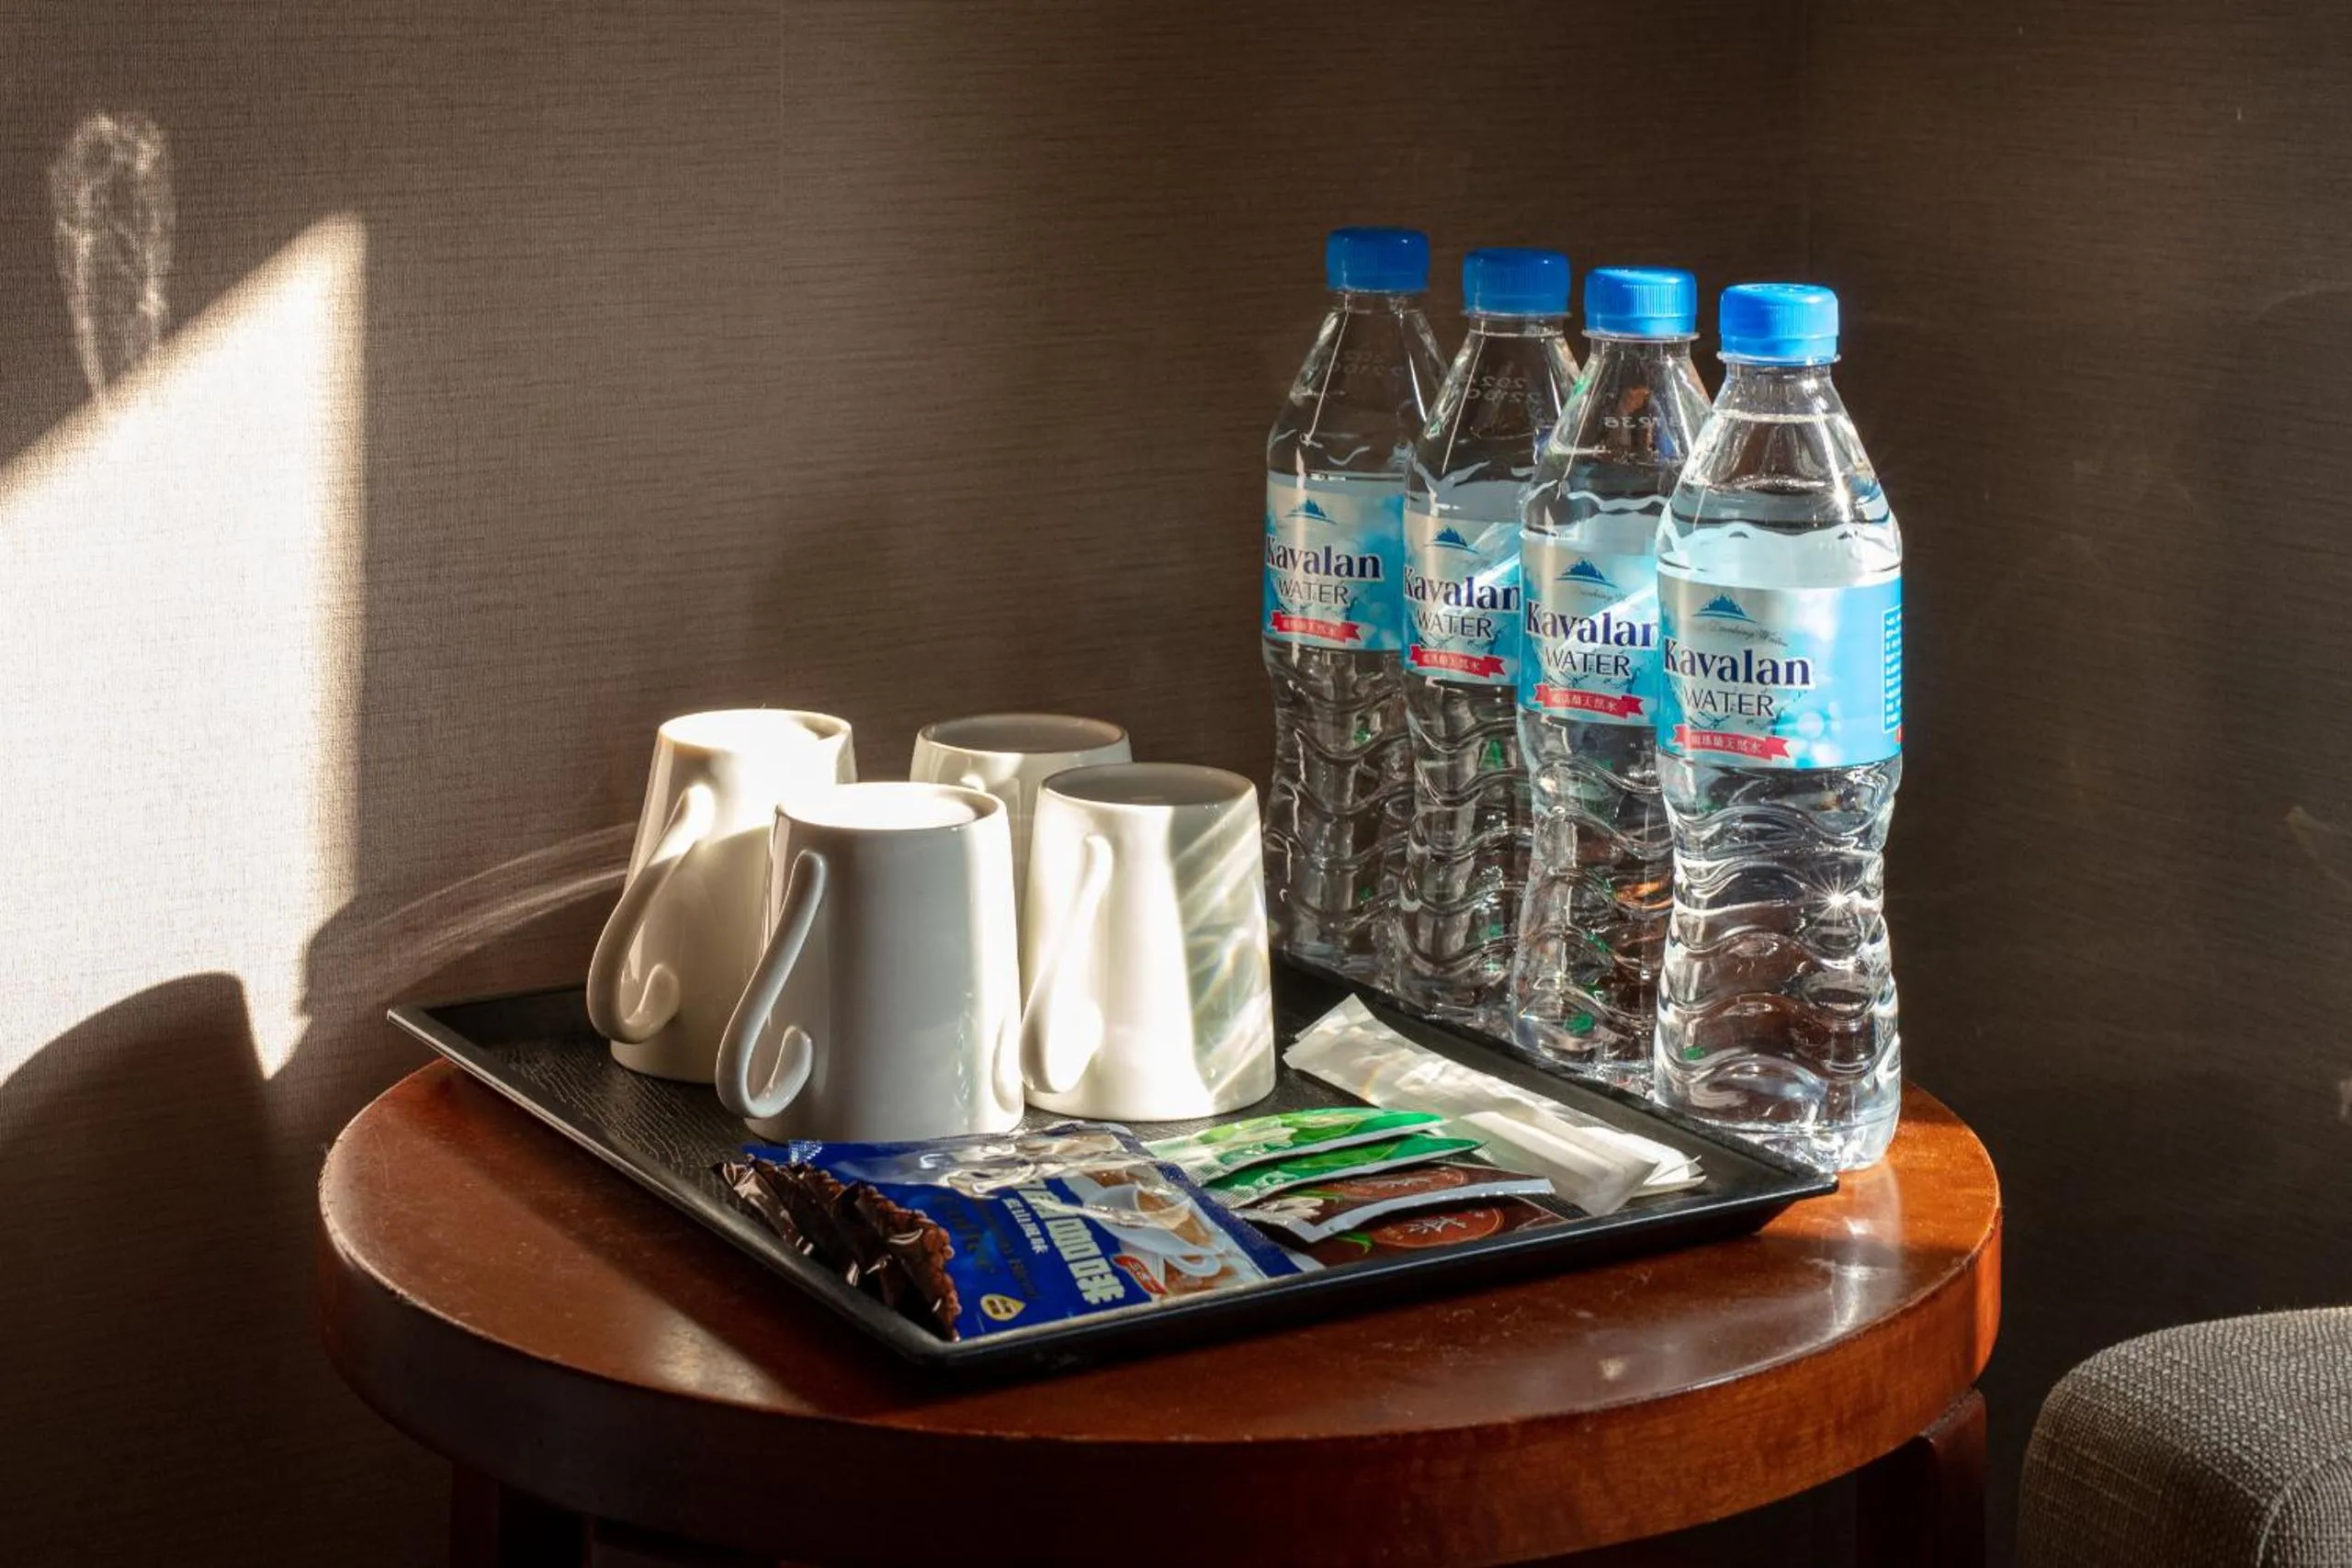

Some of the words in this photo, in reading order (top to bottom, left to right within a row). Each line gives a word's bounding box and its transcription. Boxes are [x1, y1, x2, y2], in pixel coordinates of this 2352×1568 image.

[1267, 536, 1381, 579] Kavalan
[1278, 580, 1348, 604] WATER
[1404, 565, 1521, 611] Kavalan
[1418, 610, 1492, 638] WATER
[1545, 647, 1630, 676] WATER
[1664, 637, 1810, 686] Kavalan
[1683, 686, 1775, 716] WATER
